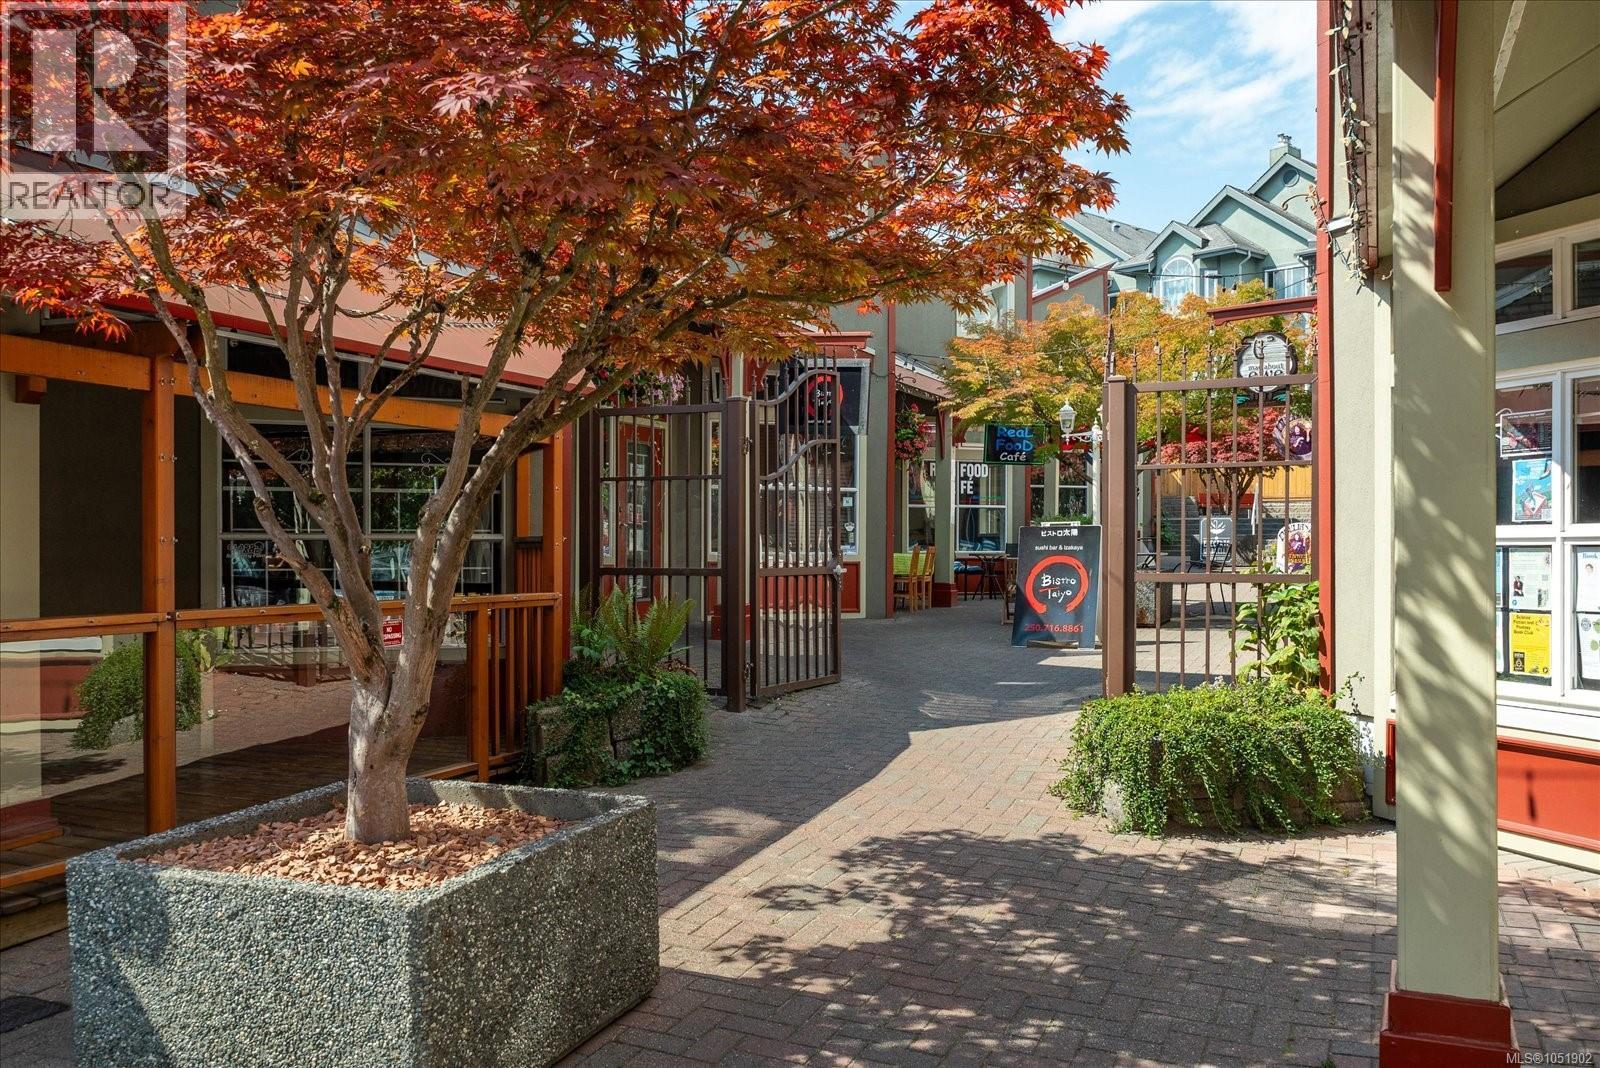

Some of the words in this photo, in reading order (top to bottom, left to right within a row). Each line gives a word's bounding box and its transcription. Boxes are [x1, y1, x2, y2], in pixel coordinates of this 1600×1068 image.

[1000, 451, 1027, 462] Café
[960, 463, 989, 478] FOOD
[960, 477, 974, 495] FÉ
[1041, 573, 1077, 587] Bistro
[1039, 587, 1072, 603] Taiyo
[1024, 623, 1084, 633] 250.716.8861
